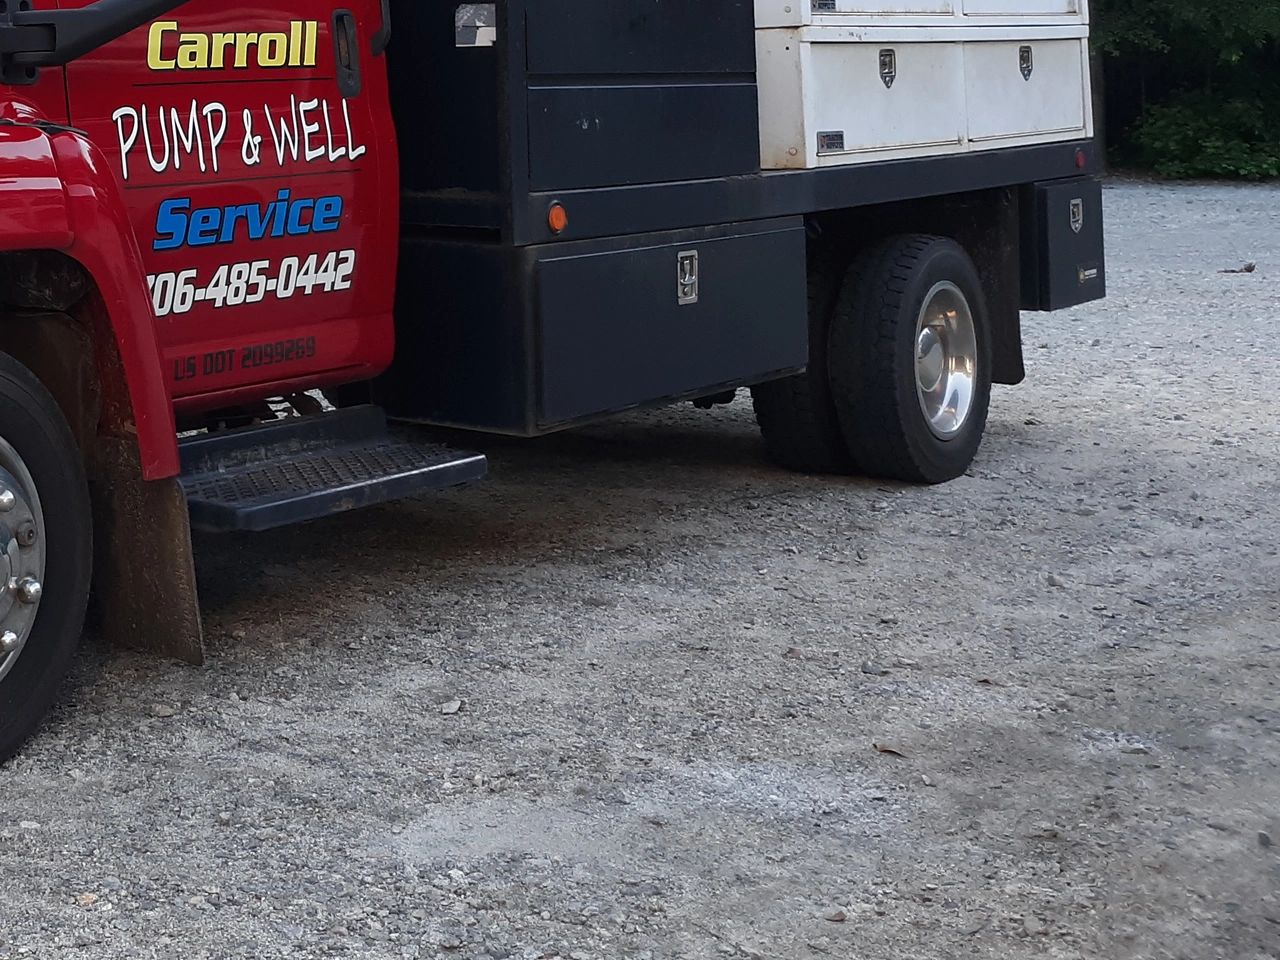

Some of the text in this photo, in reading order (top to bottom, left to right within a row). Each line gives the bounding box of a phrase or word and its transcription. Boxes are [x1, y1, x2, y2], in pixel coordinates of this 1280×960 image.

[146, 20, 318, 70] Carroll
[112, 94, 366, 180] PUMP & WELL
[152, 189, 342, 250] Service
[174, 356, 196, 382] US
[202, 349, 236, 376] DOT
